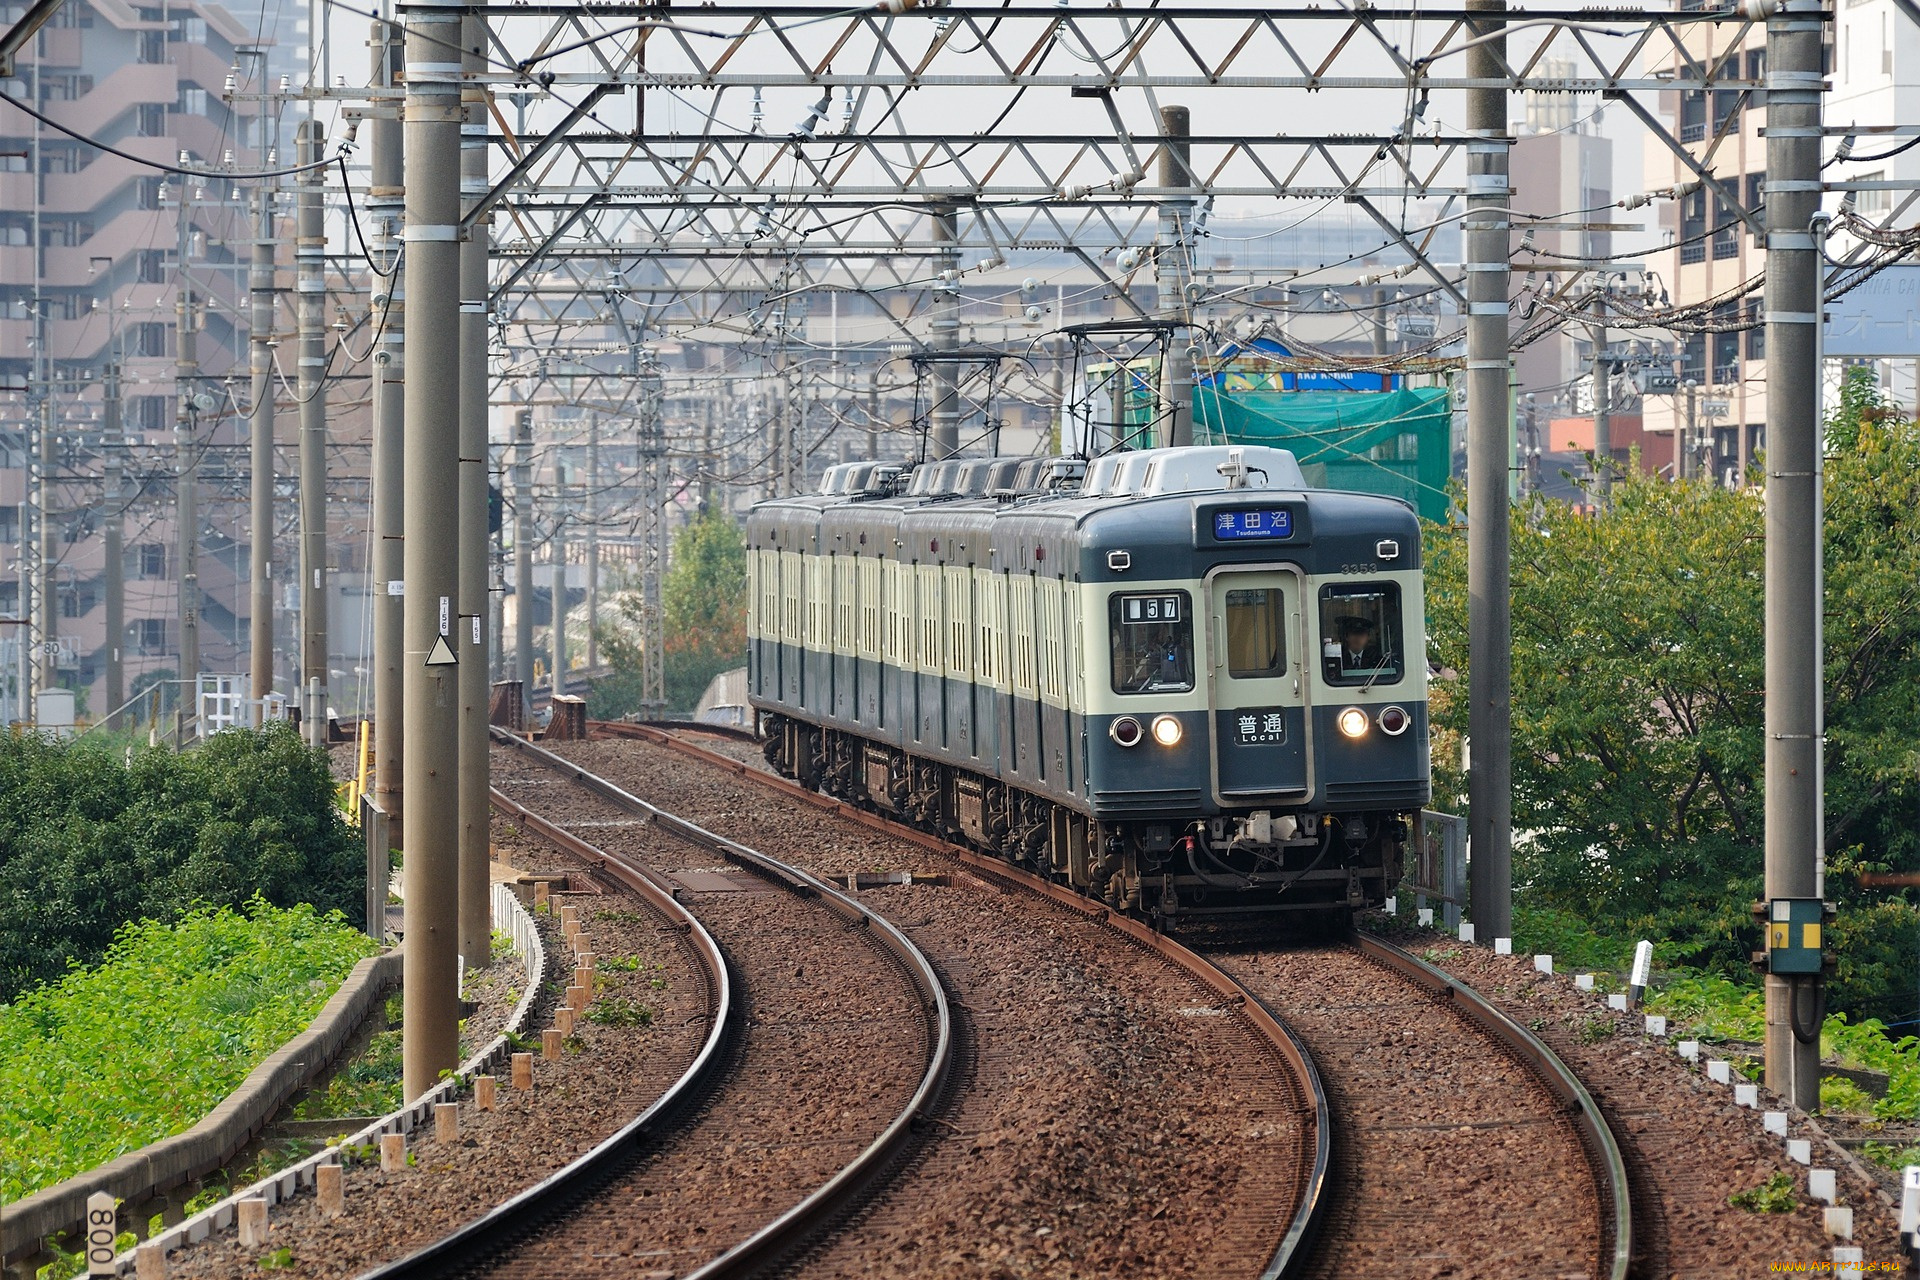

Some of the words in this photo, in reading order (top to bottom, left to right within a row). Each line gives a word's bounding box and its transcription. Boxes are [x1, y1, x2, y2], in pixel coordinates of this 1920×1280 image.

[1218, 511, 1287, 530] 津田沼
[1341, 563, 1377, 575] 3353
[1148, 601, 1174, 617] 57
[44, 642, 60, 655] 80
[1238, 713, 1282, 734] 普通
[1242, 733, 1279, 742] Local
[89, 1209, 114, 1263] 800
